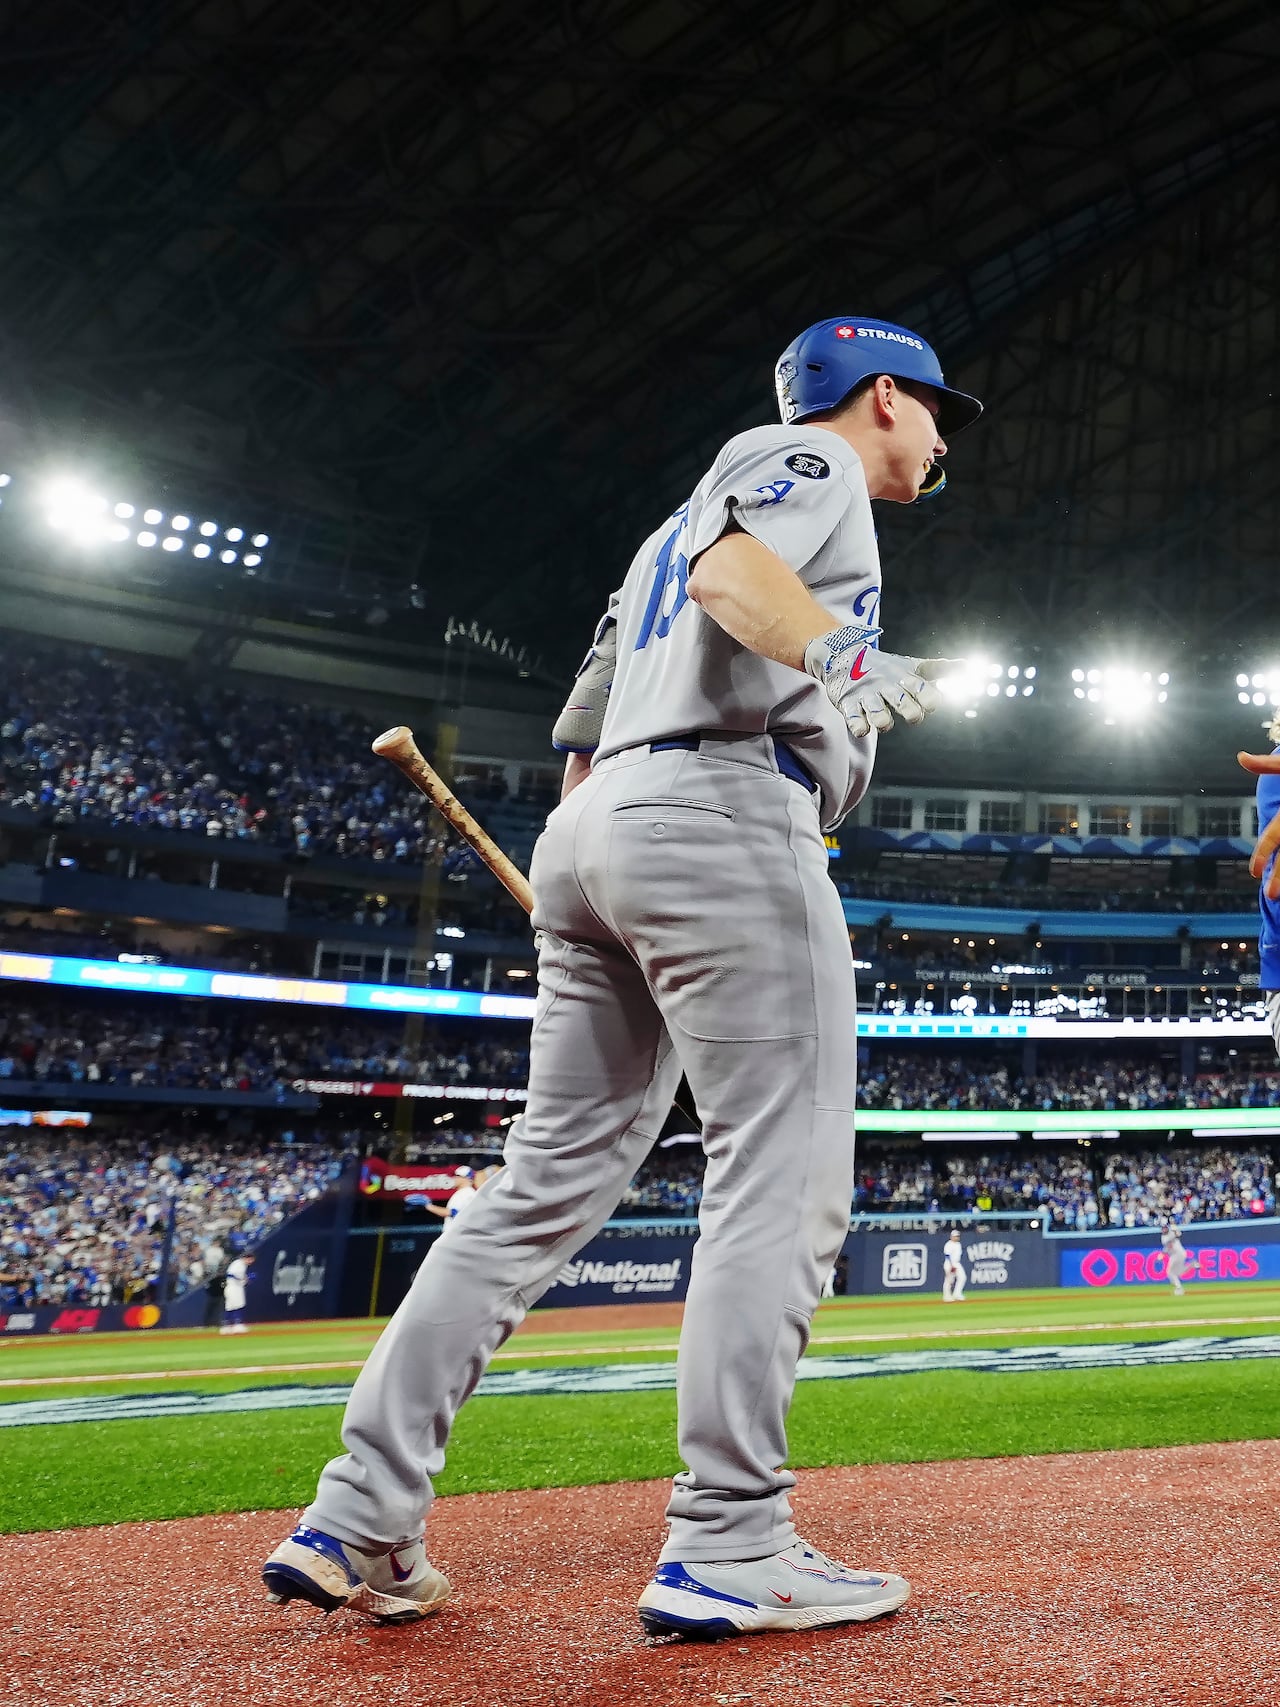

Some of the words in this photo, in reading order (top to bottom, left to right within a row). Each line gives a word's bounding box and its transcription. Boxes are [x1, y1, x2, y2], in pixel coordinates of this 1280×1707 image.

[857, 328, 924, 350] STRAUSS
[792, 460, 821, 477] 34
[1084, 973, 1104, 985] JOE
[1107, 973, 1147, 985] CARTER
[966, 1241, 1015, 1262] HEINZ
[580, 1257, 679, 1284] National
